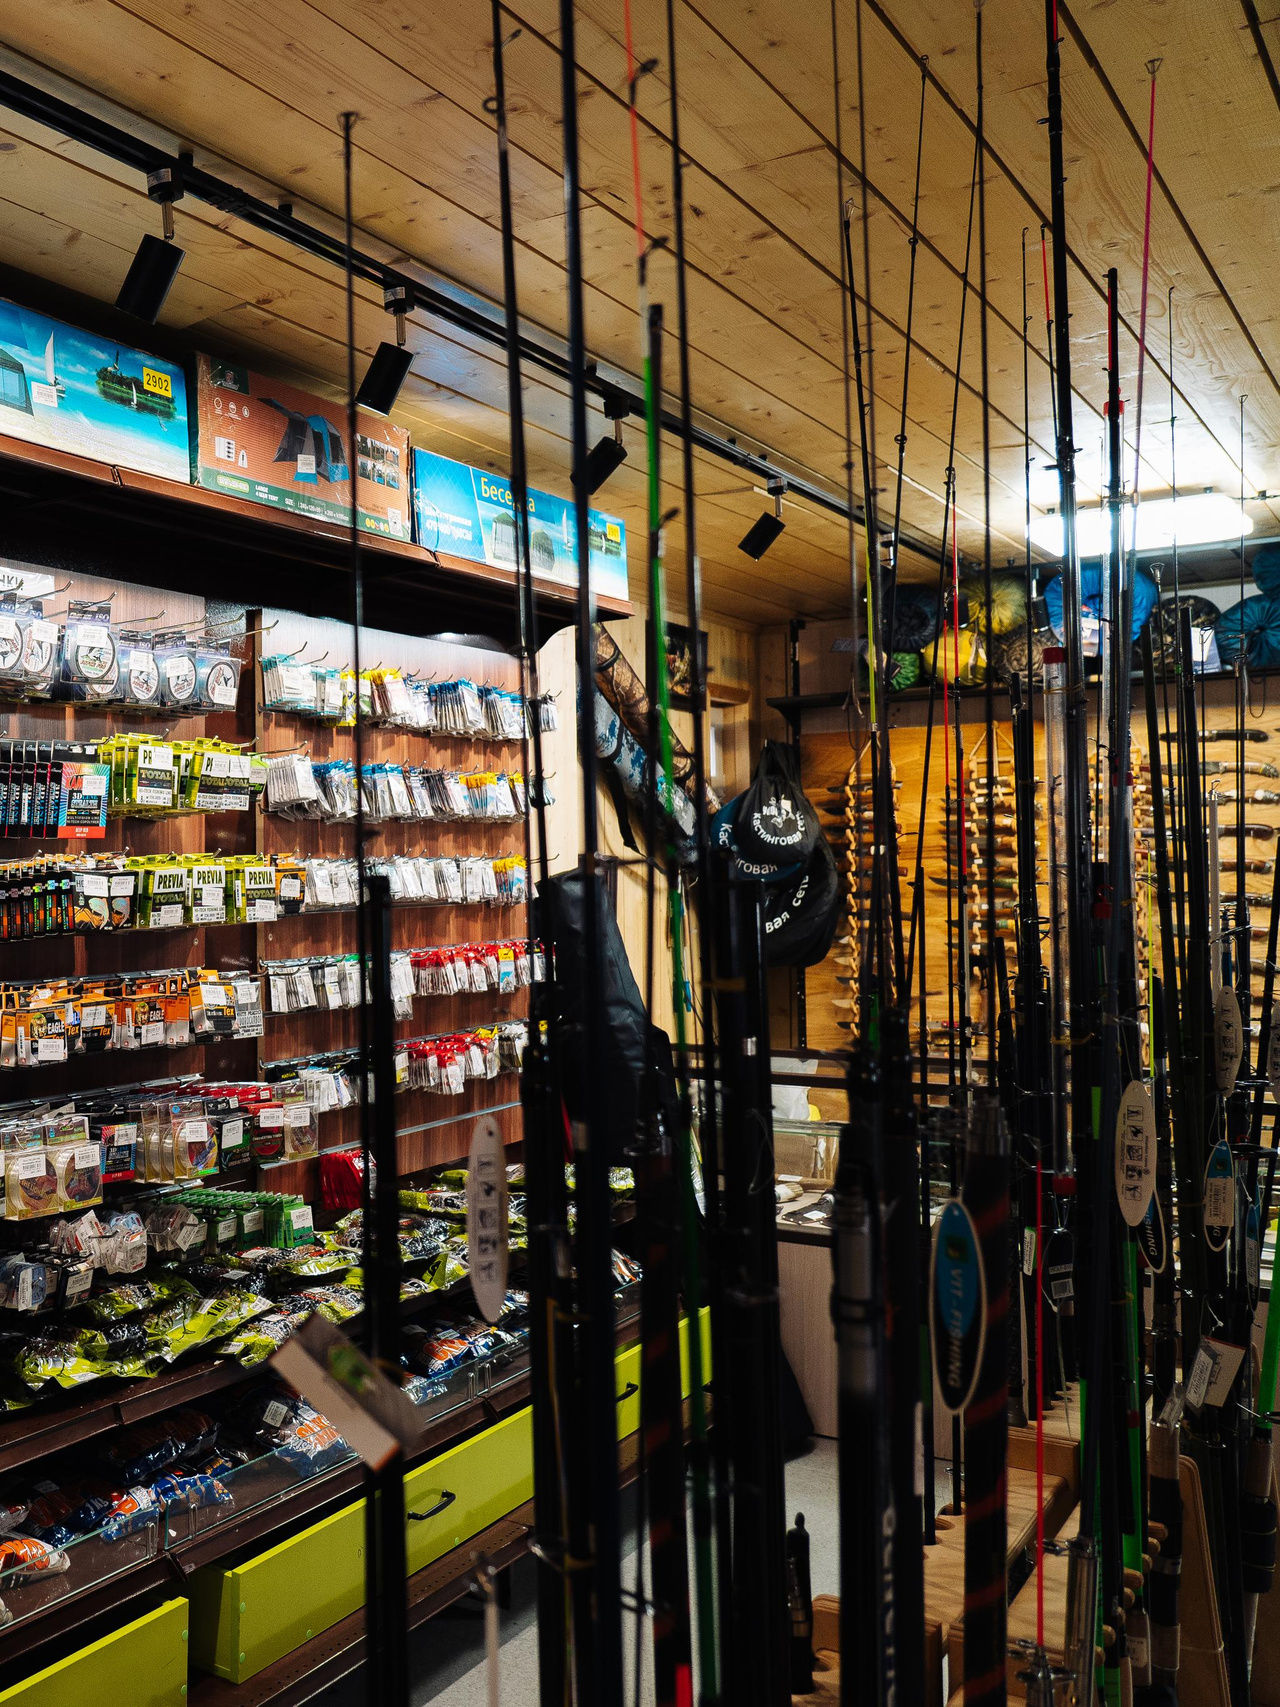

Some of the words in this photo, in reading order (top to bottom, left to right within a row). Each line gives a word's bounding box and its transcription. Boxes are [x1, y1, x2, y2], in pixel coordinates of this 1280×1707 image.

[145, 372, 171, 394] 2902
[481, 477, 535, 513] Бесеа
[140, 769, 172, 779] TOTAL
[157, 873, 184, 889] PREVIA
[197, 869, 223, 884] PREVIA
[248, 870, 274, 886] PREVIA
[150, 1010, 165, 1022] EAGLE
[223, 1007, 234, 1017] Tex
[47, 1019, 65, 1035] EAGLE
[99, 1027, 111, 1036] Tex
